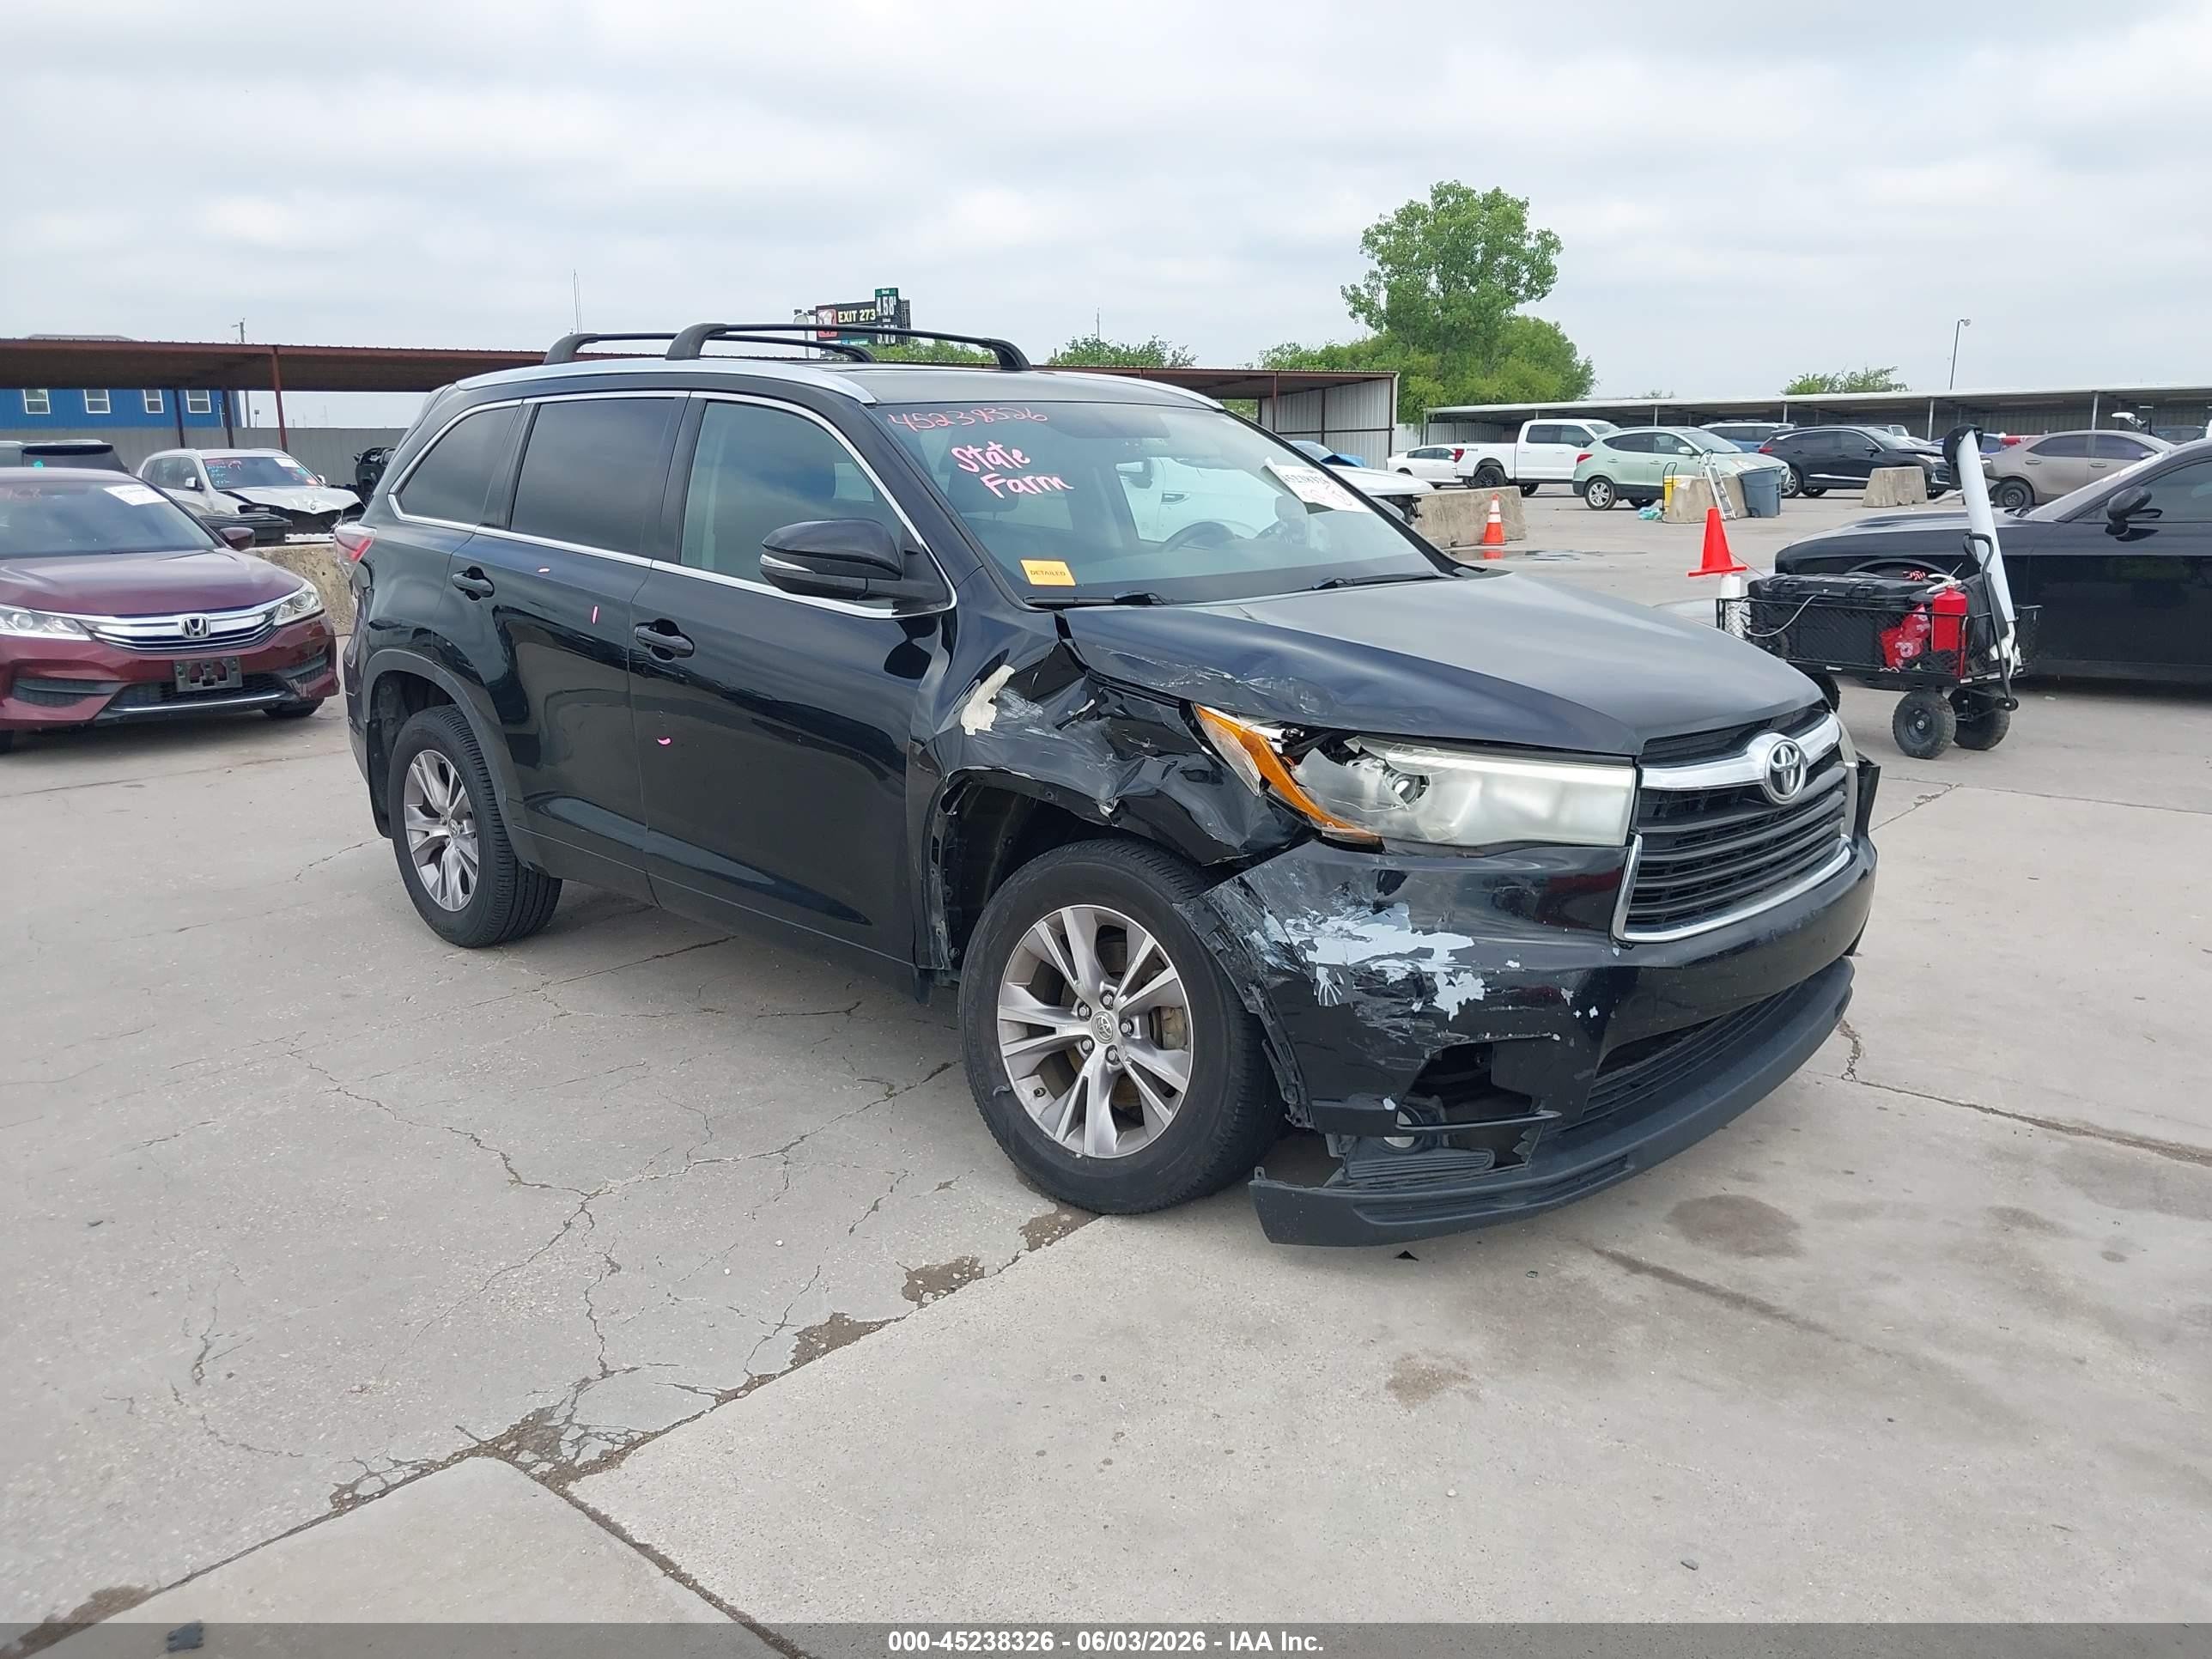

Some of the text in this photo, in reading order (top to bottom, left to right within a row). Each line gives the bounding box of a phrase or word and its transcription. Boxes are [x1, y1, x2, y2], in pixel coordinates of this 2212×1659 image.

[838, 308, 876, 324] EXIT 273
[888, 407, 1048, 432] 45238326
[951, 441, 1030, 473] State
[980, 473, 1074, 499] Farm
